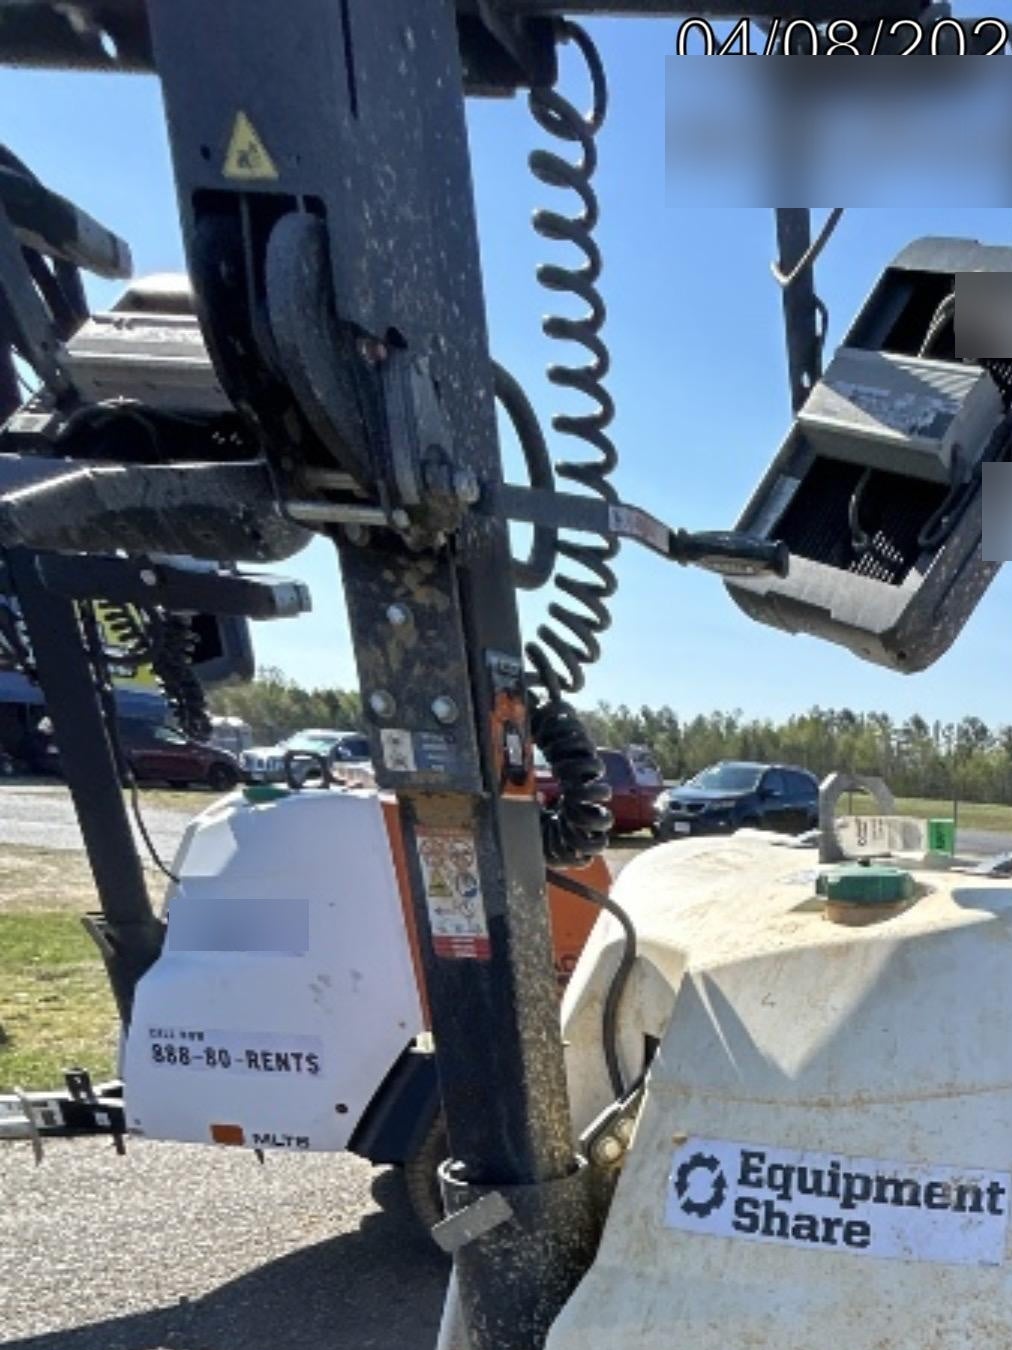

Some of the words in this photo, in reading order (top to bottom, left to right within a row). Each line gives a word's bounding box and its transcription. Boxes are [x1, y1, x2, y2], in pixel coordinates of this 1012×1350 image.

[152, 1043, 321, 1075] 888-80-RENTS
[737, 1149, 1006, 1216] Equipment
[732, 1197, 872, 1248] Share
